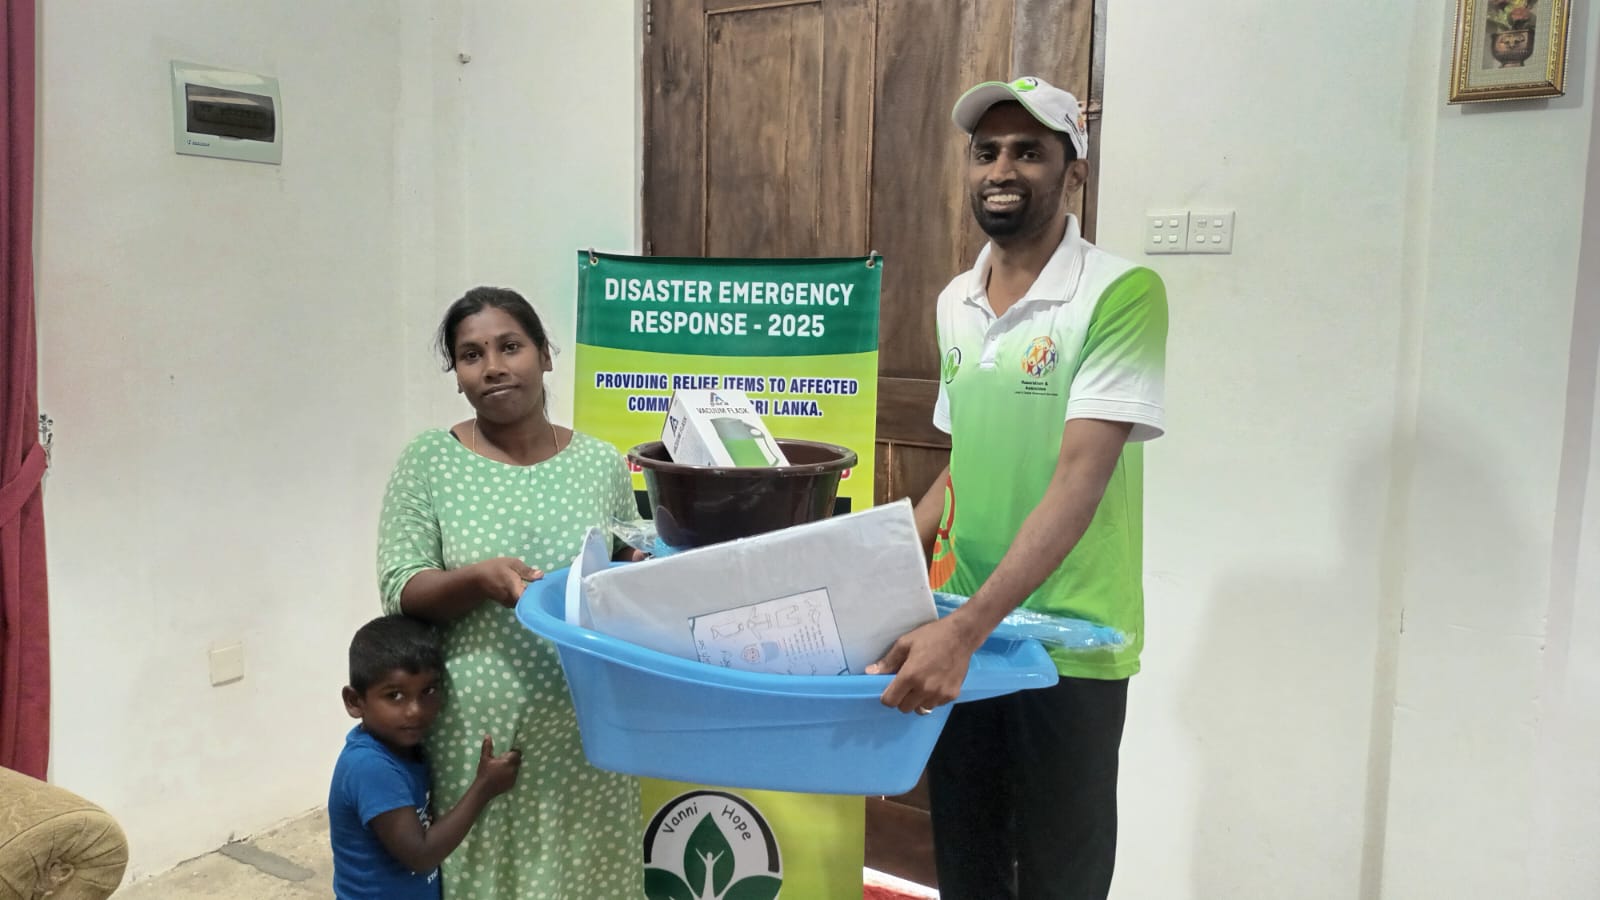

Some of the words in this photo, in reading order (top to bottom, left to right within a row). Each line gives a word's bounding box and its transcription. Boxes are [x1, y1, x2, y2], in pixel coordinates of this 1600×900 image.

[604, 278, 713, 304] DISASTER
[718, 281, 854, 306] EMERGENCY
[629, 310, 747, 336] RESPONSE
[753, 322, 762, 330] -
[767, 313, 825, 337] 2025
[595, 373, 668, 390] PROVIDING
[673, 375, 719, 391] RELIEF
[723, 376, 765, 393] ITEMS
[769, 378, 786, 393] TO
[789, 378, 858, 395] AFFECTED
[750, 400, 768, 415] RI
[773, 401, 823, 417] LANKA.
[662, 803, 698, 834] Vanni
[722, 805, 751, 840] Hope
